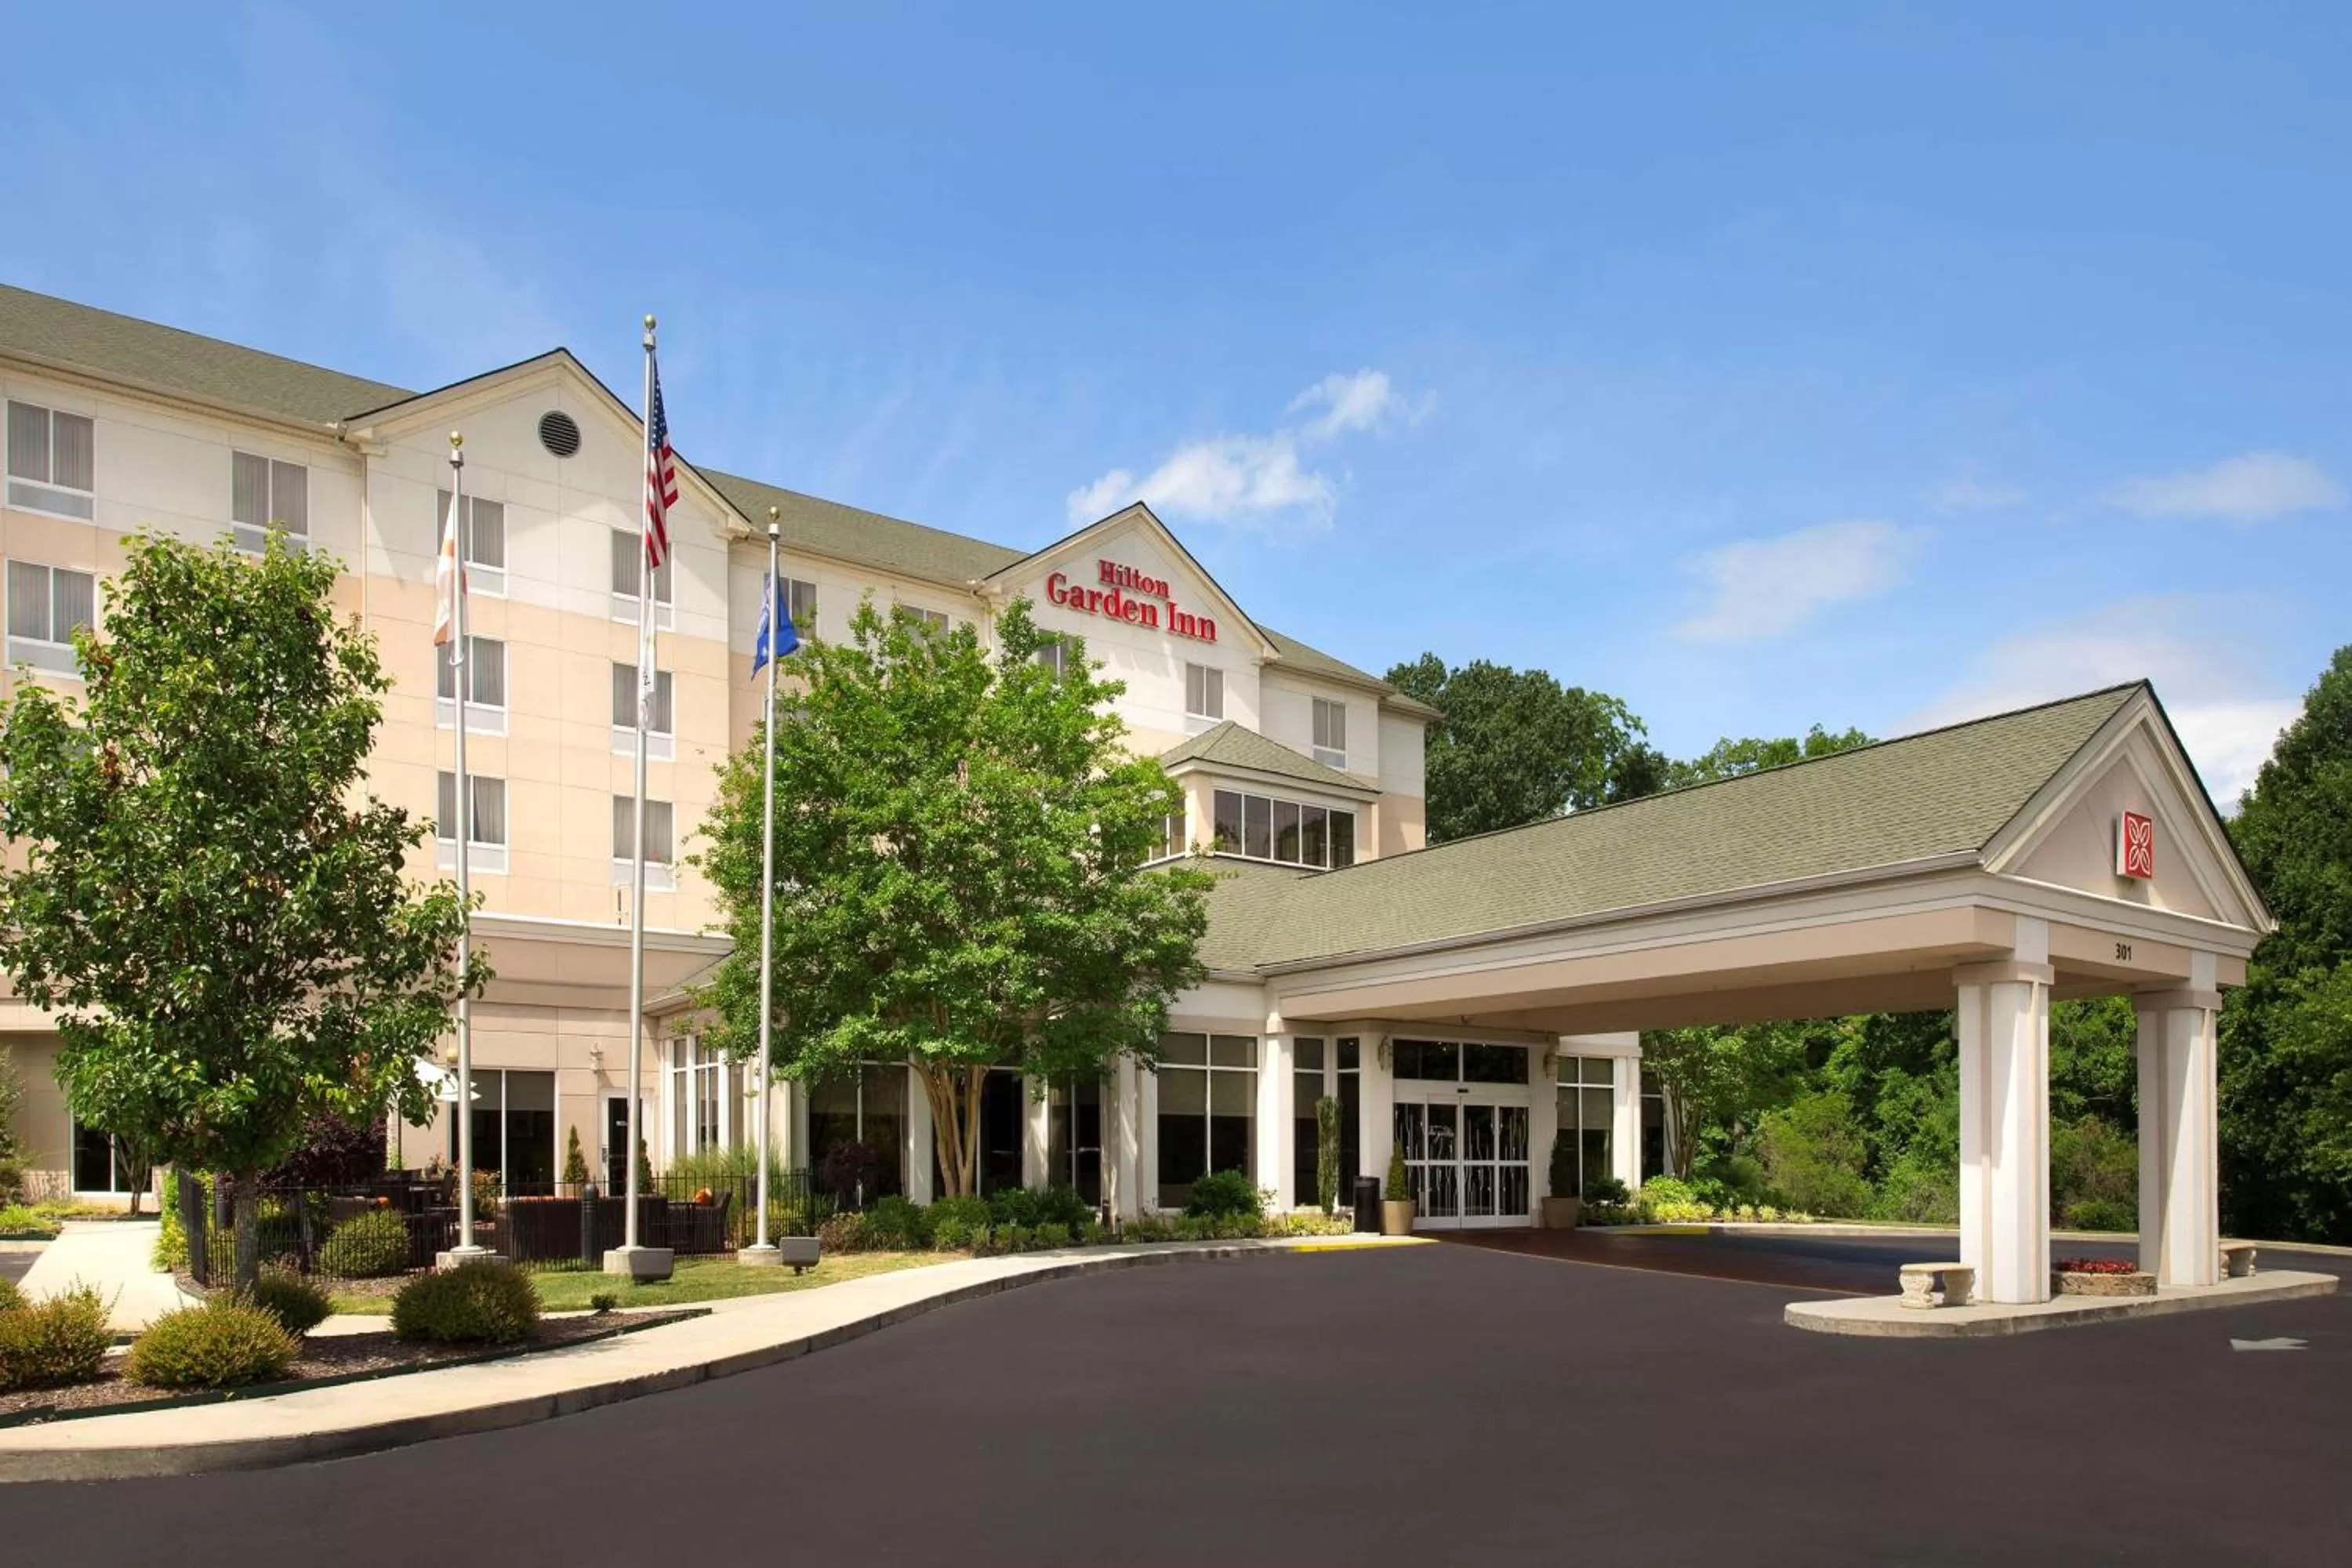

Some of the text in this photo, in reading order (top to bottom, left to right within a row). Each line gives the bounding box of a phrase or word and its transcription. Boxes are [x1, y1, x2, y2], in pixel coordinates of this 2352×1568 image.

[1098, 559, 1170, 599] Hilton
[1047, 572, 1217, 641] Garden Inn
[2115, 942, 2132, 960] 301
